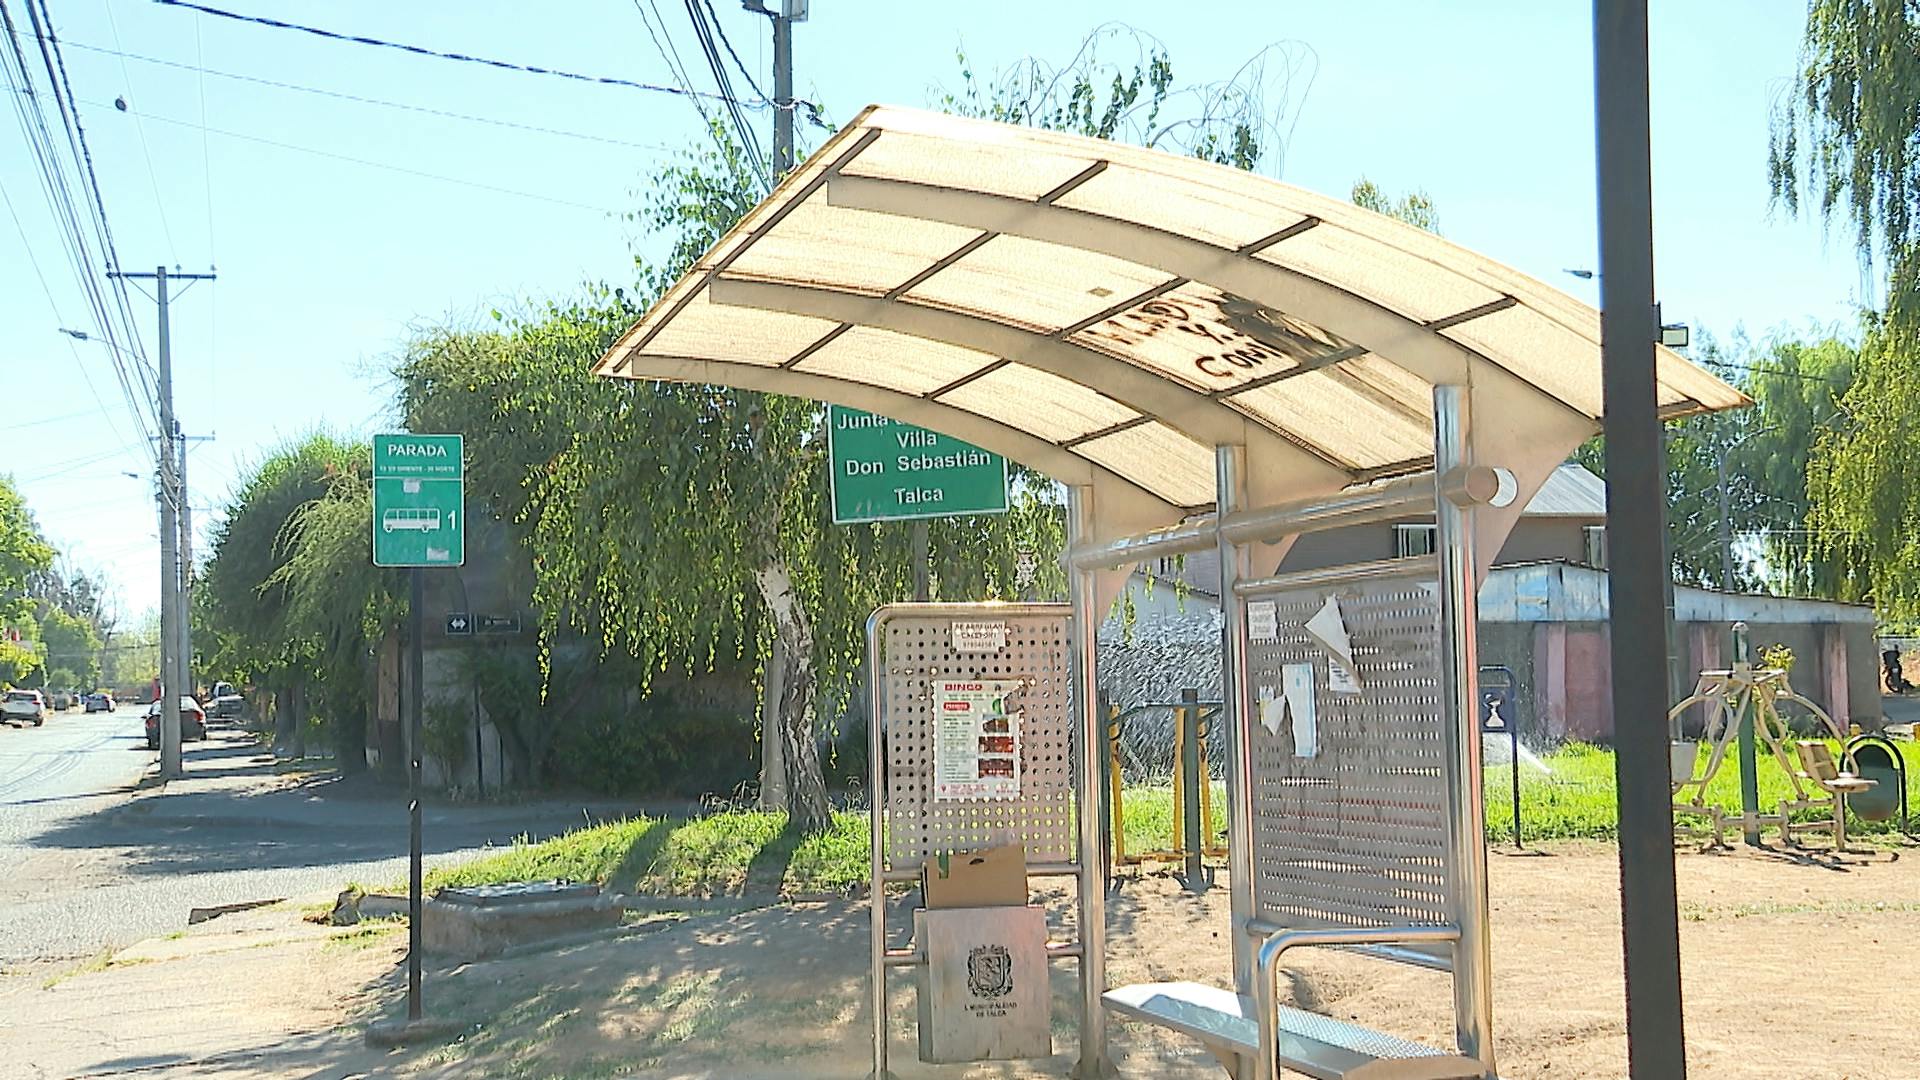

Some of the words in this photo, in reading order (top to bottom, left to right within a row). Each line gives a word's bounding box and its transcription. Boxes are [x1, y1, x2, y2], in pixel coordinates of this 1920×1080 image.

[837, 412, 889, 430] Junta
[896, 430, 938, 449] Villa
[387, 444, 448, 457] PARADA
[846, 459, 885, 476] Don
[897, 449, 992, 472] Sebastián
[893, 486, 945, 505] Talca
[447, 510, 456, 531] 1
[944, 683, 983, 691] BINGO
